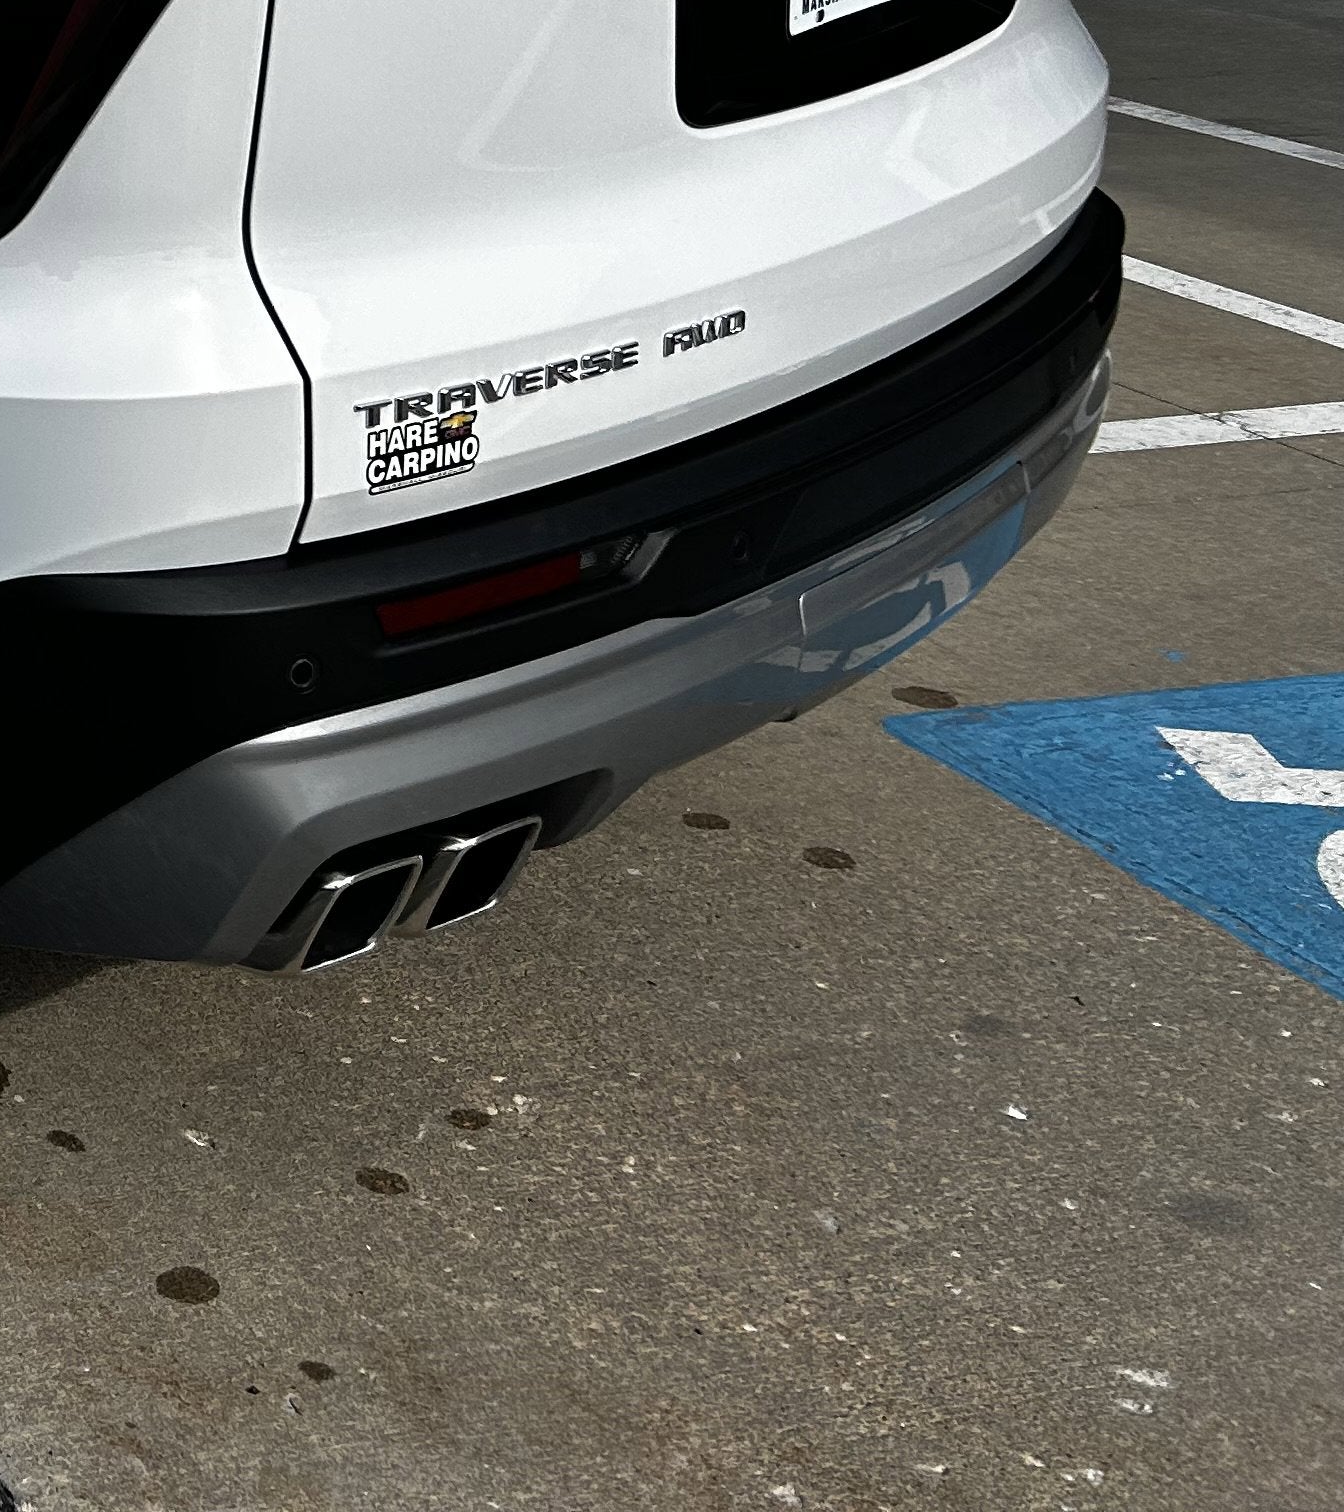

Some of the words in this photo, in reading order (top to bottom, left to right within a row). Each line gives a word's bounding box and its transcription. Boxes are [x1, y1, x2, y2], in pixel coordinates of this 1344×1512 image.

[353, 340, 640, 429] TRAVERSE
[662, 309, 747, 358] AWD
[367, 435, 479, 484] CARPINO
[368, 419, 439, 458] HARE
